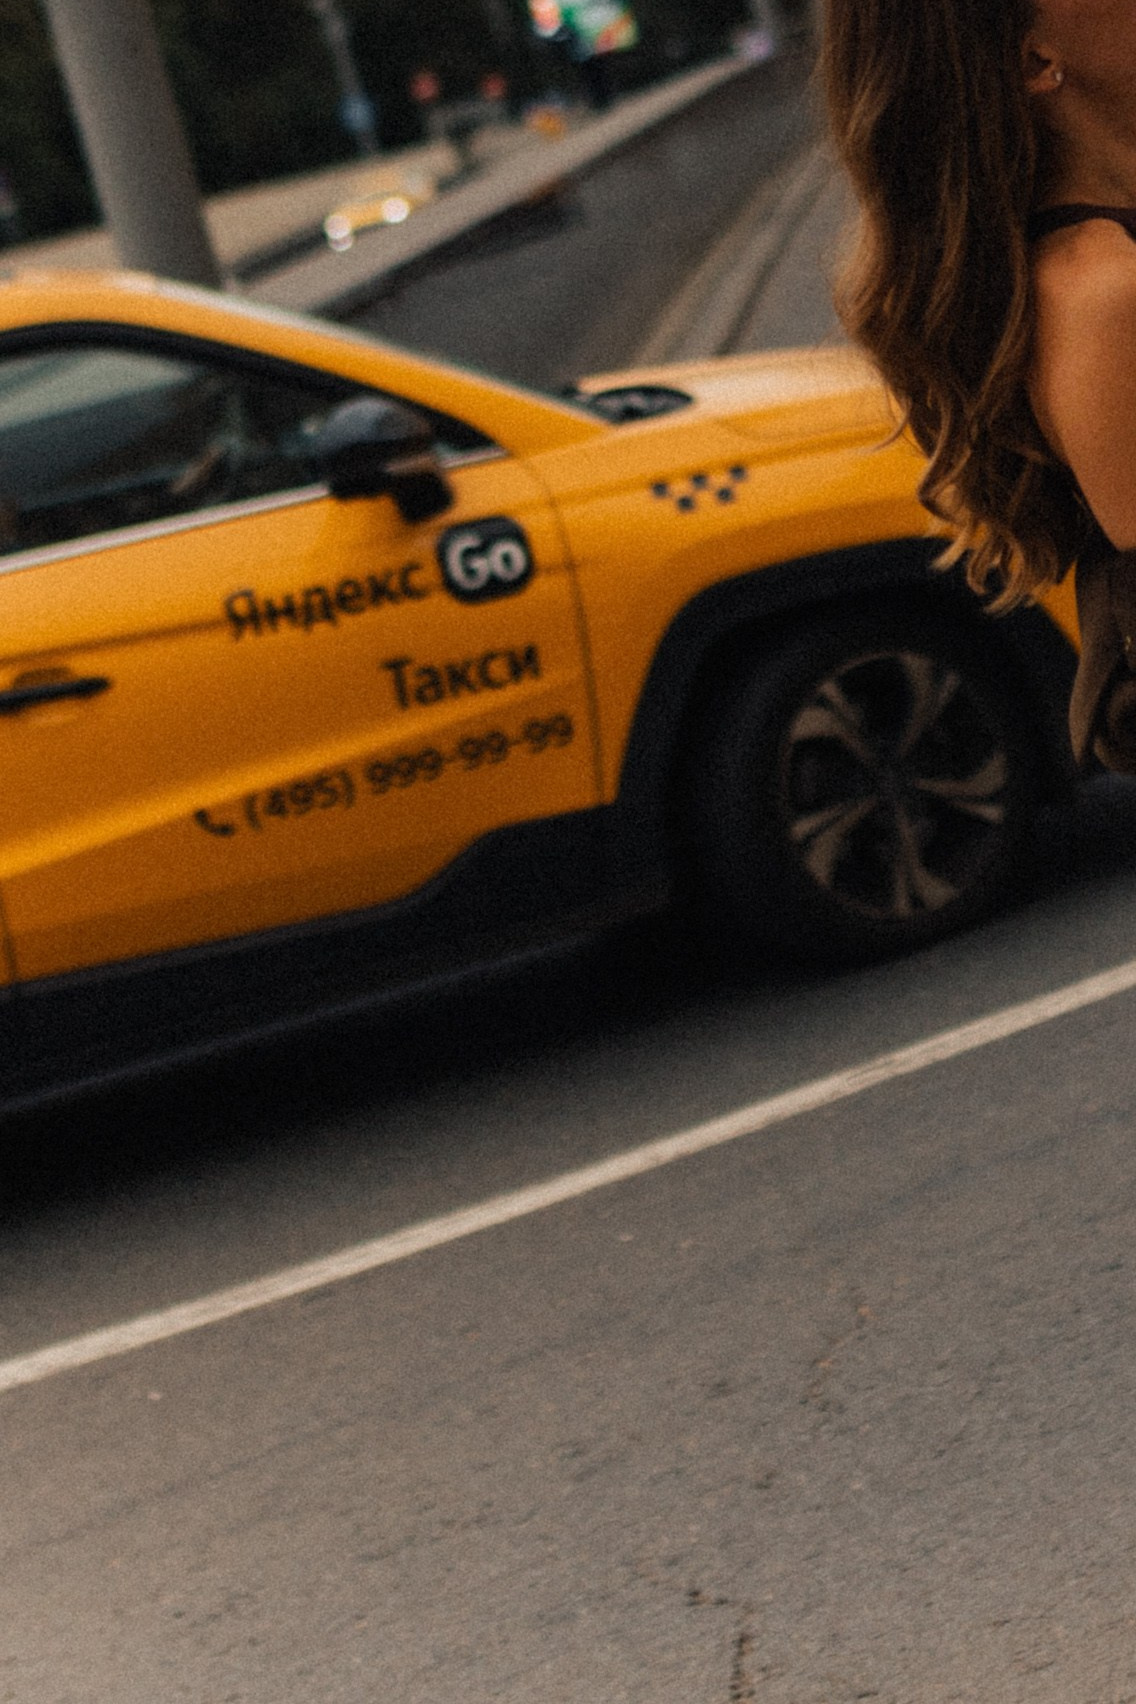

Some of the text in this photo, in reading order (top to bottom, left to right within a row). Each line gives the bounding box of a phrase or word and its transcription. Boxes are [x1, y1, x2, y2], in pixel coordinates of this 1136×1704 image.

[223, 531, 529, 640] Яндекс Go
[382, 644, 541, 710] Такси
[244, 713, 575, 831] (495) 999-99-99
